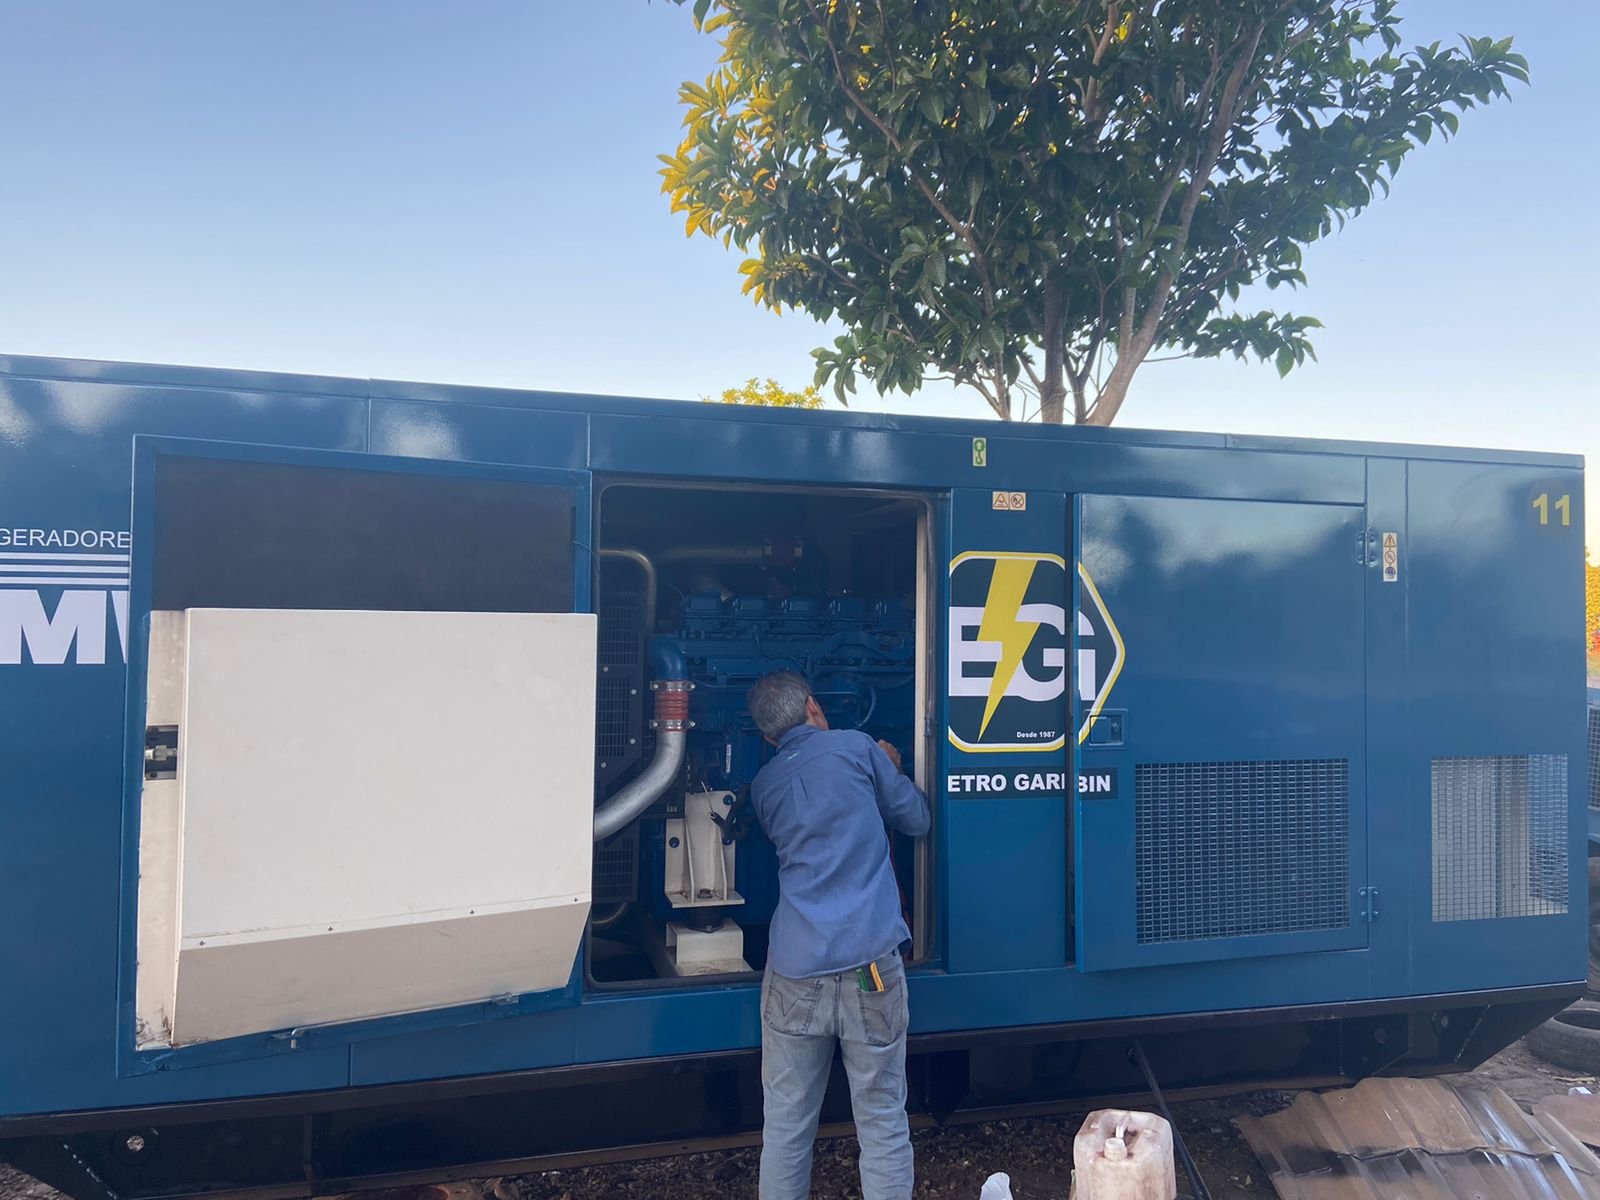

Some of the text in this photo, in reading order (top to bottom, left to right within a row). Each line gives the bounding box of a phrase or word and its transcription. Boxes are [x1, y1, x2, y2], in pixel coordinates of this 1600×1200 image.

[1533, 493, 1570, 526] 11
[0, 528, 131, 548] GERADORE
[947, 774, 1007, 793] ETRO
